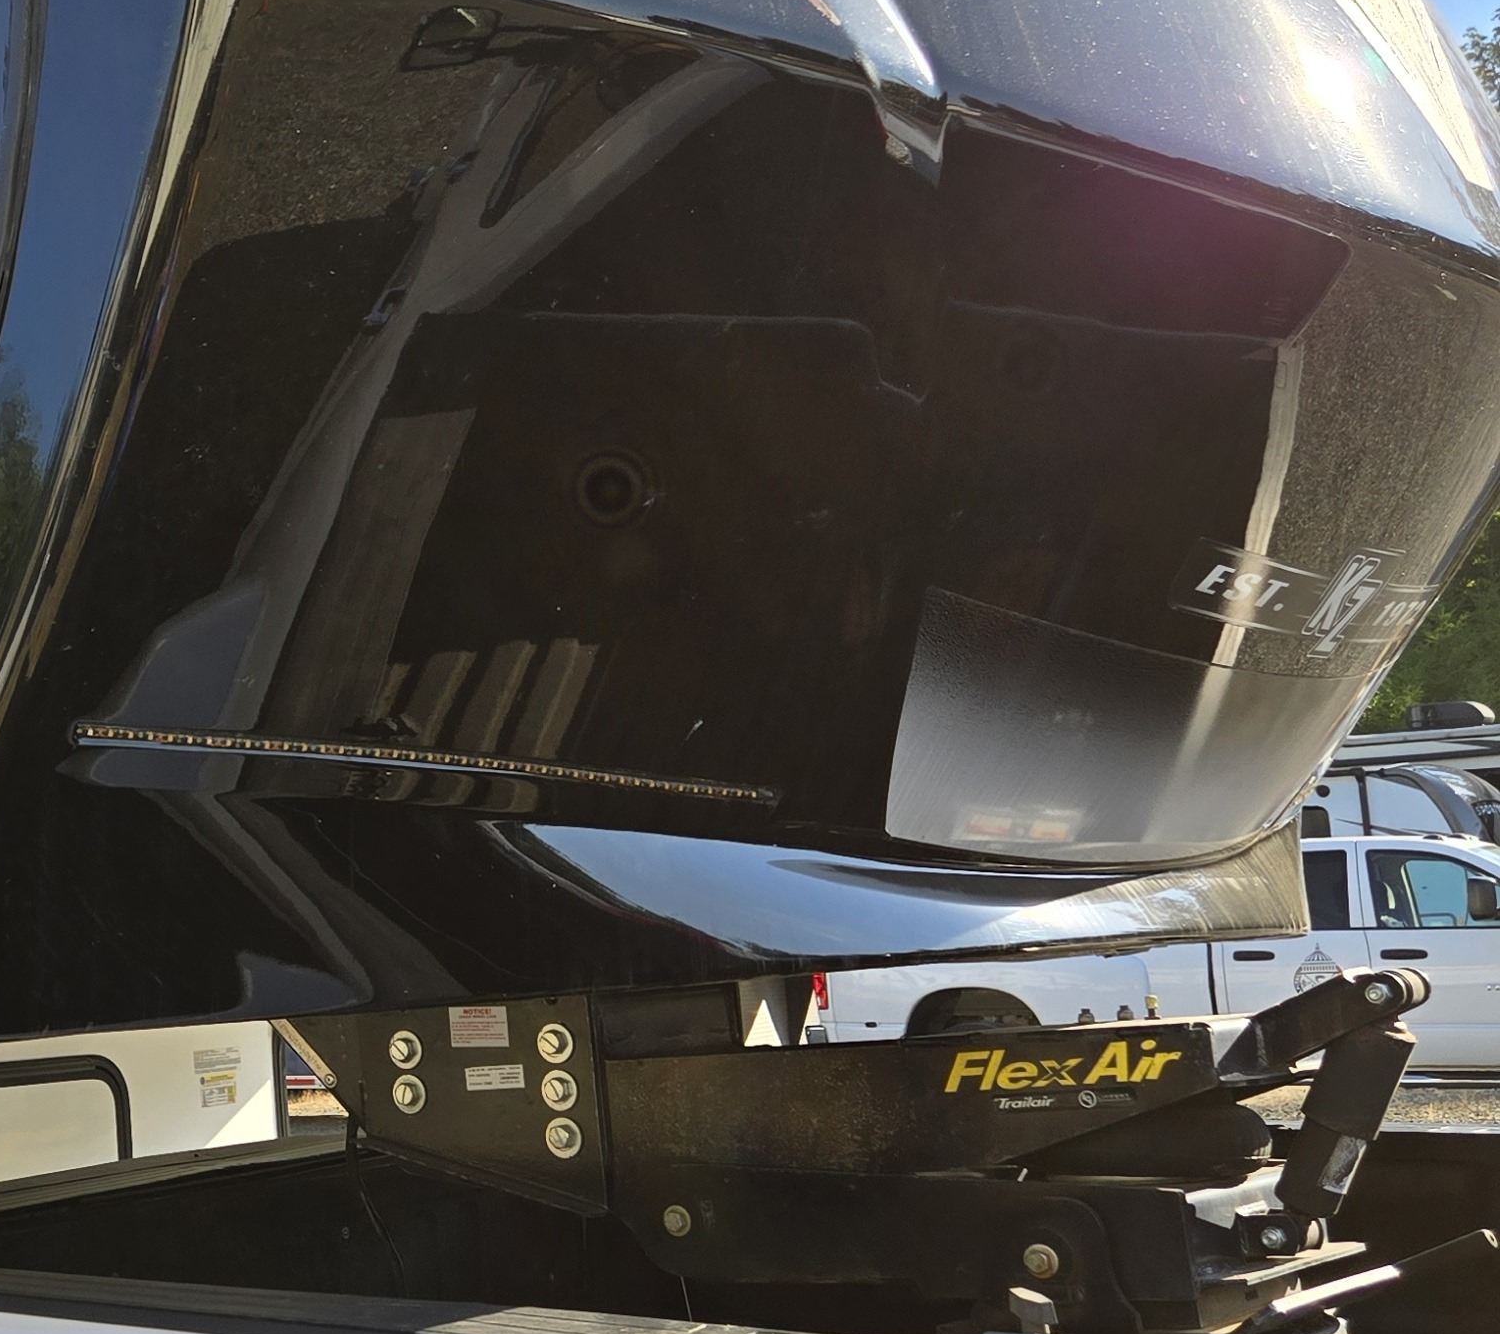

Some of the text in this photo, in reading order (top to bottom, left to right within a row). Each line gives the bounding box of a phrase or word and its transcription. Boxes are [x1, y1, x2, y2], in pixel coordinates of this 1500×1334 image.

[1194, 564, 1290, 612] EST.
[944, 1039, 1183, 1093] Flex Air
[993, 1095, 1055, 1110] Trailair
